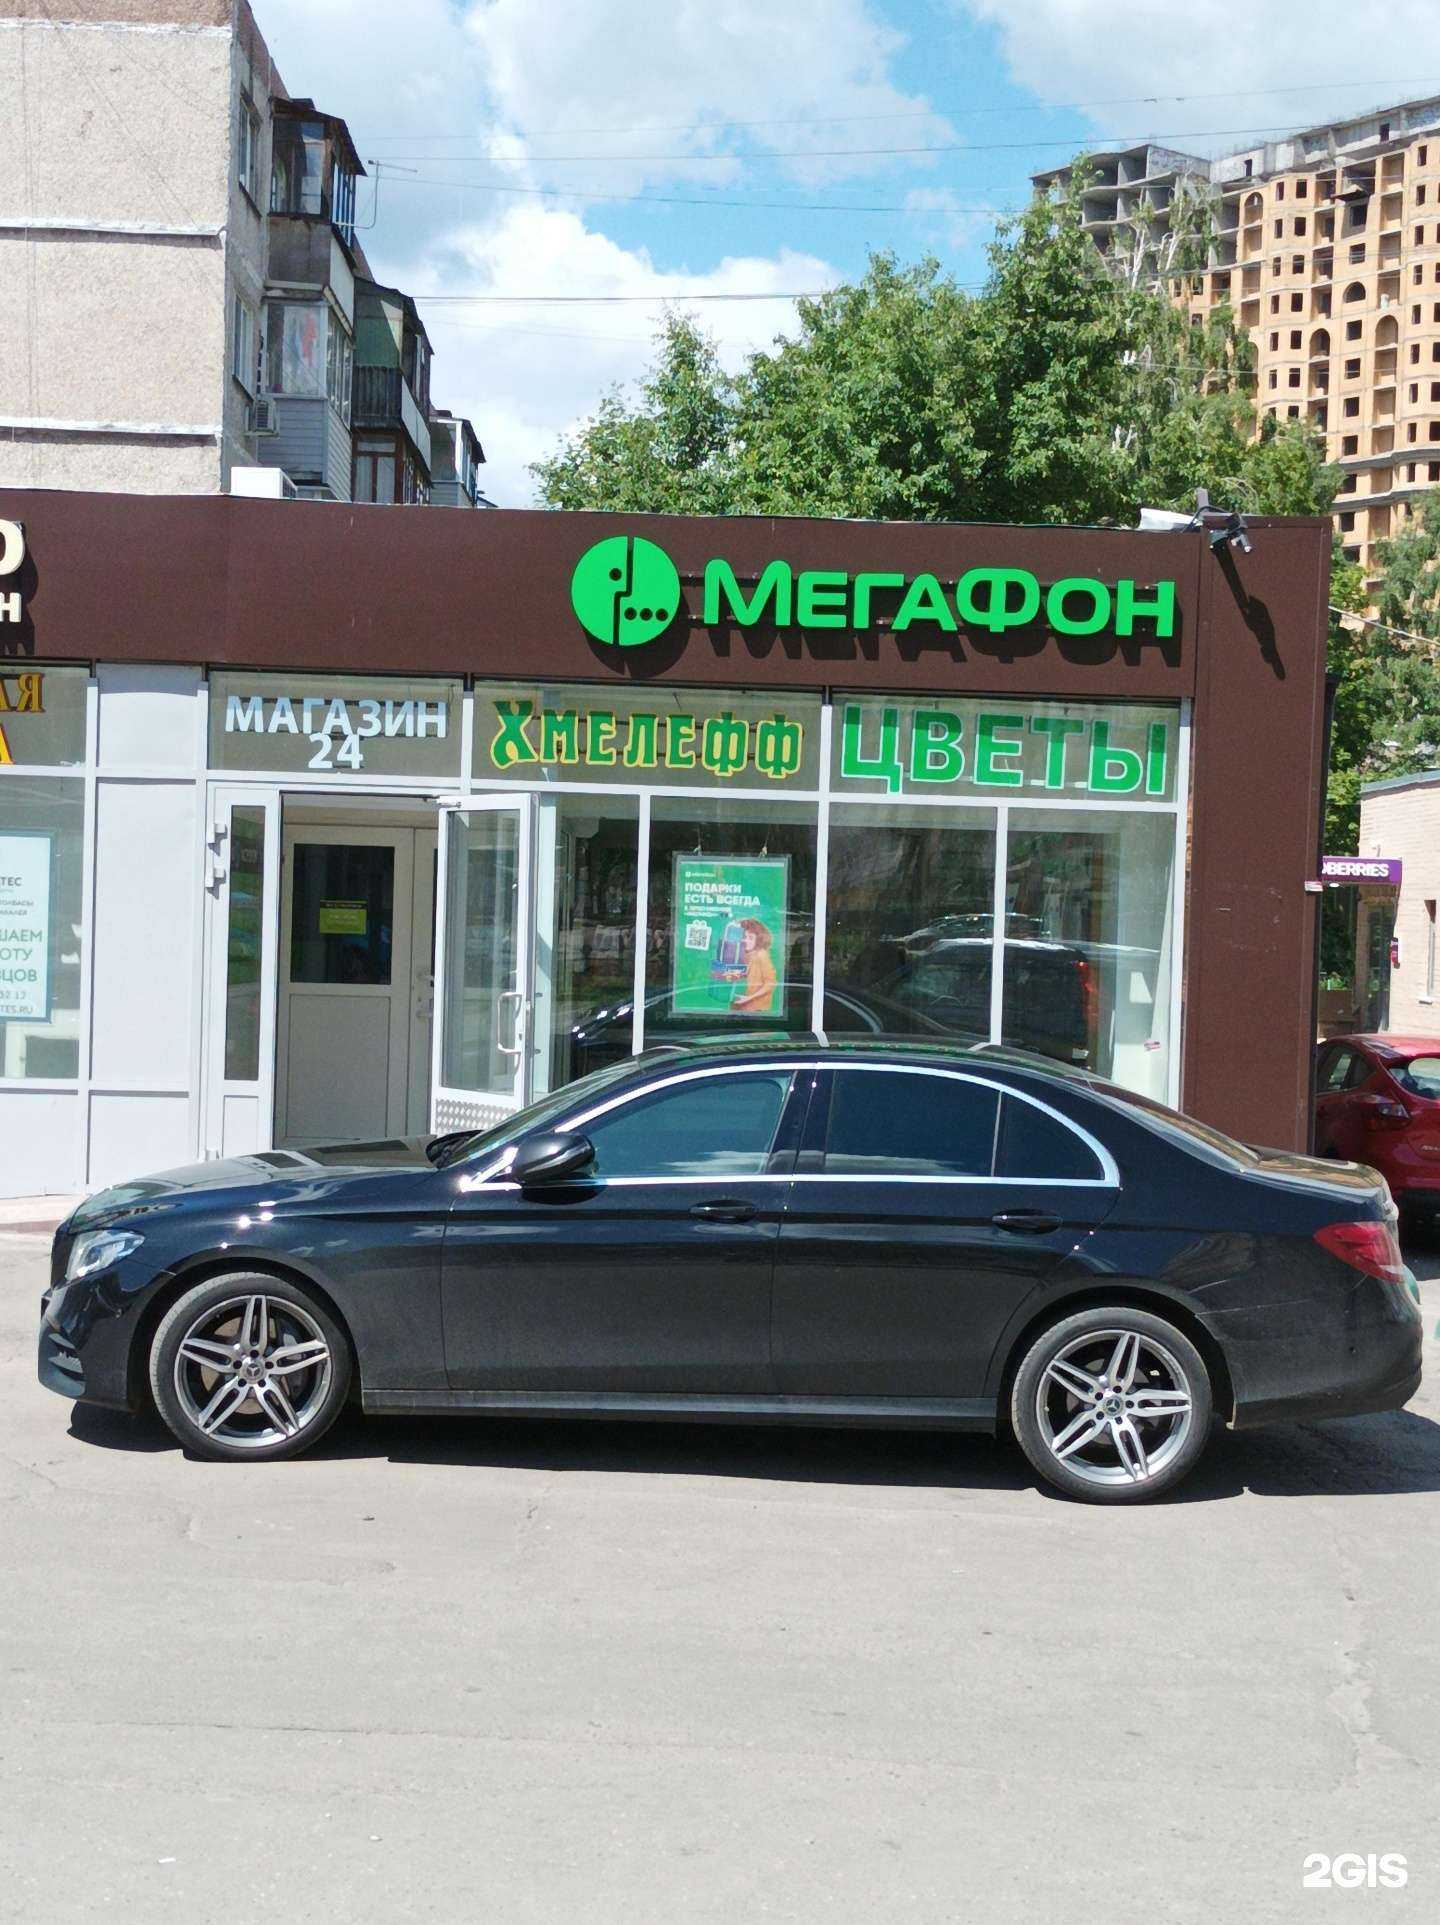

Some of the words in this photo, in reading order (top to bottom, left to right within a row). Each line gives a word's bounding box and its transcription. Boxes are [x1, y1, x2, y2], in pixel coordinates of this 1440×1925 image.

[703, 558, 1177, 638] МЕГАФОН
[225, 695, 447, 739] МАГАЗИН
[308, 733, 364, 770] 24
[490, 700, 803, 779] ХМЕЛЕФФ
[840, 702, 1168, 795] ЦВЕТЫ
[685, 882, 742, 894] ПОДАРКИ
[685, 894, 714, 904] ЕСТЬ
[717, 895, 760, 906] ВСЕГДА
